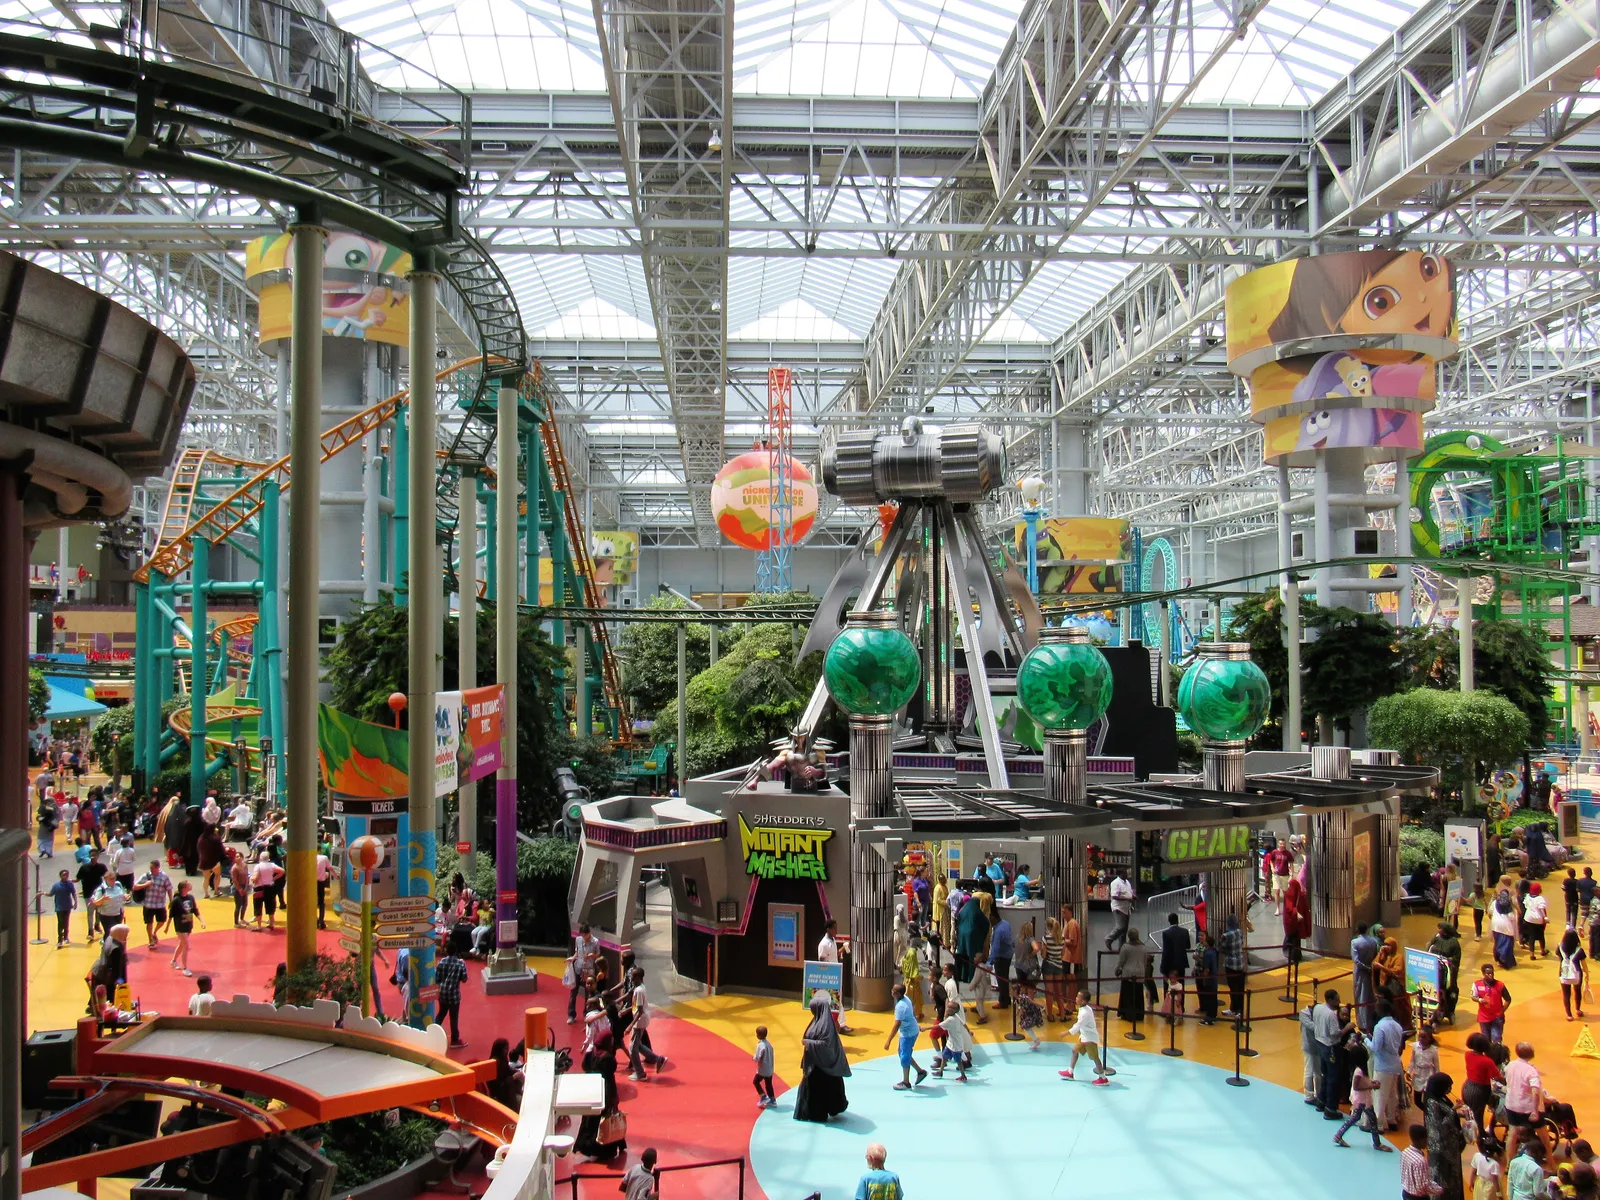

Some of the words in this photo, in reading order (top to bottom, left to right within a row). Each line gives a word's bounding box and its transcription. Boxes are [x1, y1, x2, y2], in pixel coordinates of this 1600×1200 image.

[371, 801, 395, 812] TICKETS
[754, 814, 825, 826] SHREDDER'S
[738, 813, 832, 863] MUTANT
[1168, 823, 1250, 860] GEAR
[746, 851, 827, 880] MASHER
[1221, 858, 1248, 870] MUTANT
[400, 911, 424, 919] Services
